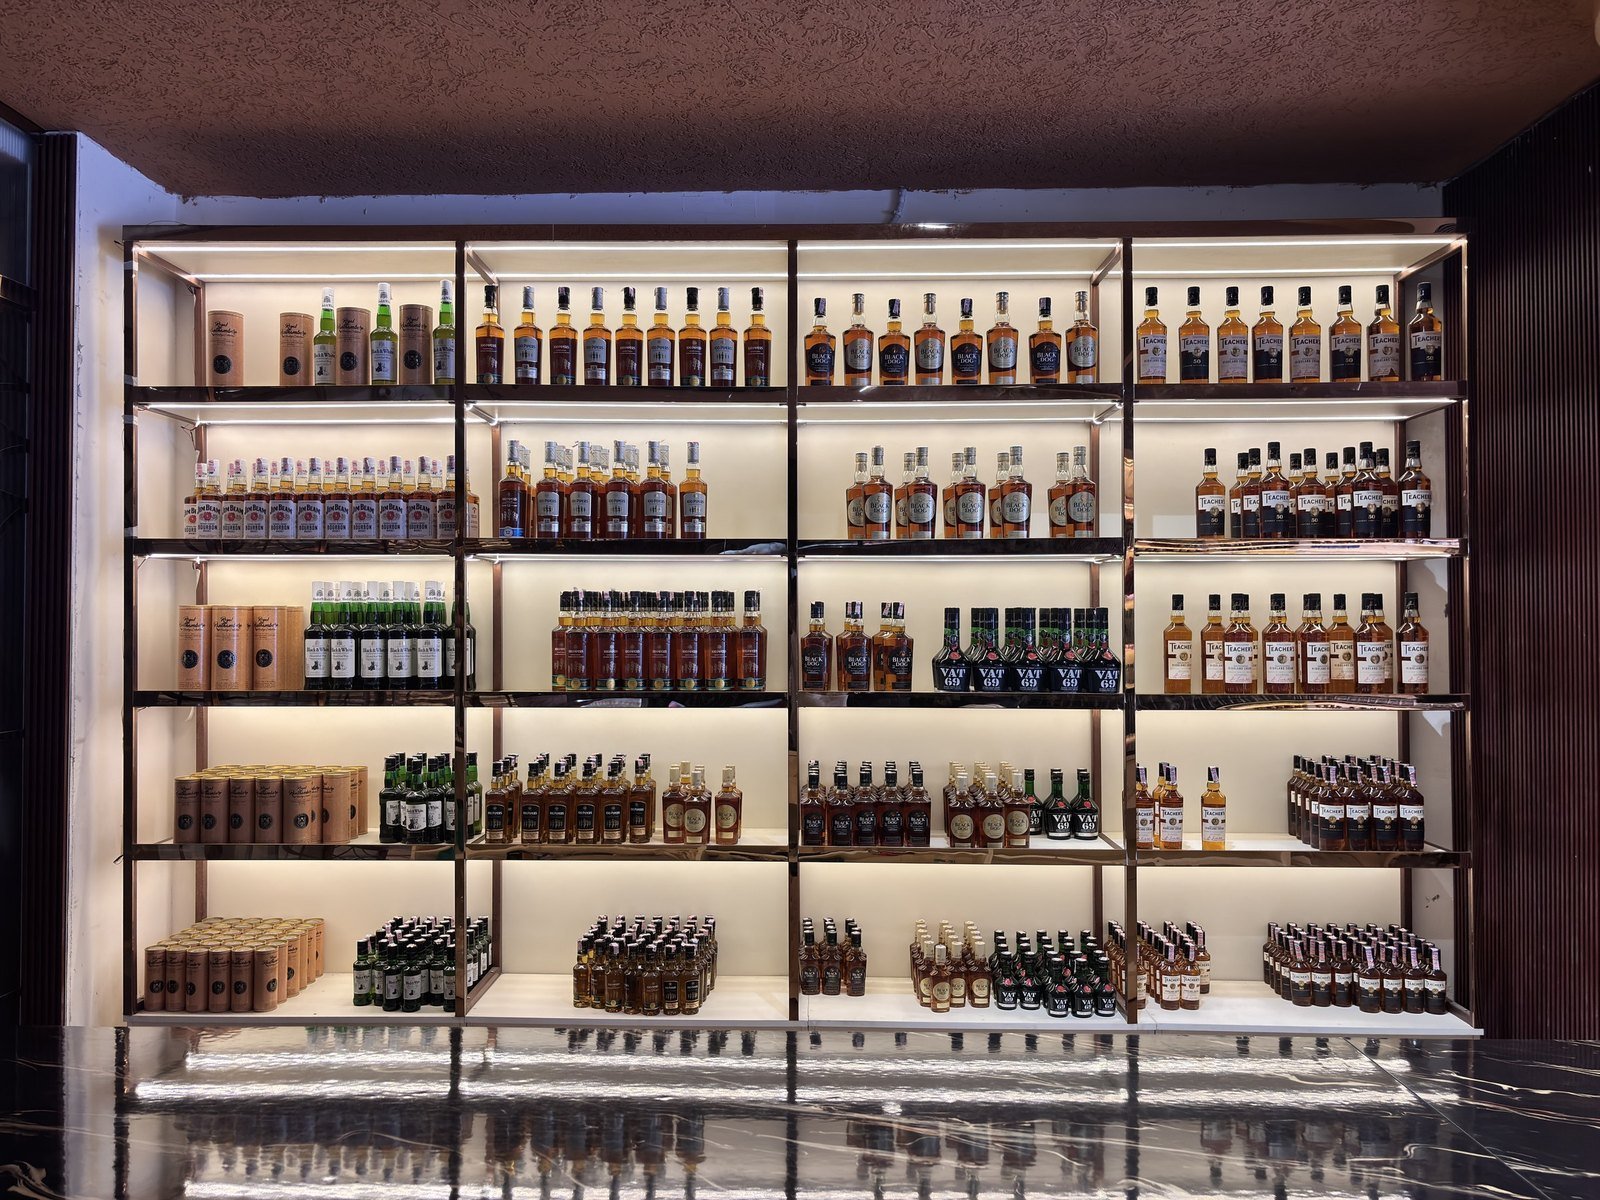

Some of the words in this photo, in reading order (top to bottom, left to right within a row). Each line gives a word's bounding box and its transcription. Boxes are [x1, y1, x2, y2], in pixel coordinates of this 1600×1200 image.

[206, 504, 221, 514] BEAM
[230, 504, 243, 514] BEAM
[252, 504, 266, 514] BEAM
[278, 504, 292, 514] BEAM
[306, 504, 321, 515] BEAM
[335, 504, 348, 514] BEAM
[360, 504, 374, 514] BEAM
[388, 503, 403, 514] BEAM
[416, 503, 430, 514] BEAM
[940, 667, 966, 678] VAT
[979, 668, 1005, 678] VAT
[1016, 669, 1042, 678] VAT
[1058, 669, 1082, 679] VAT
[1095, 670, 1119, 679] VAT
[944, 677, 960, 686] 69
[984, 678, 999, 687] 69
[1021, 678, 1037, 687] 69
[1062, 679, 1078, 687] 69
[1100, 679, 1116, 688] 69
[1053, 814, 1072, 822] VAT
[1078, 814, 1097, 822] VAT
